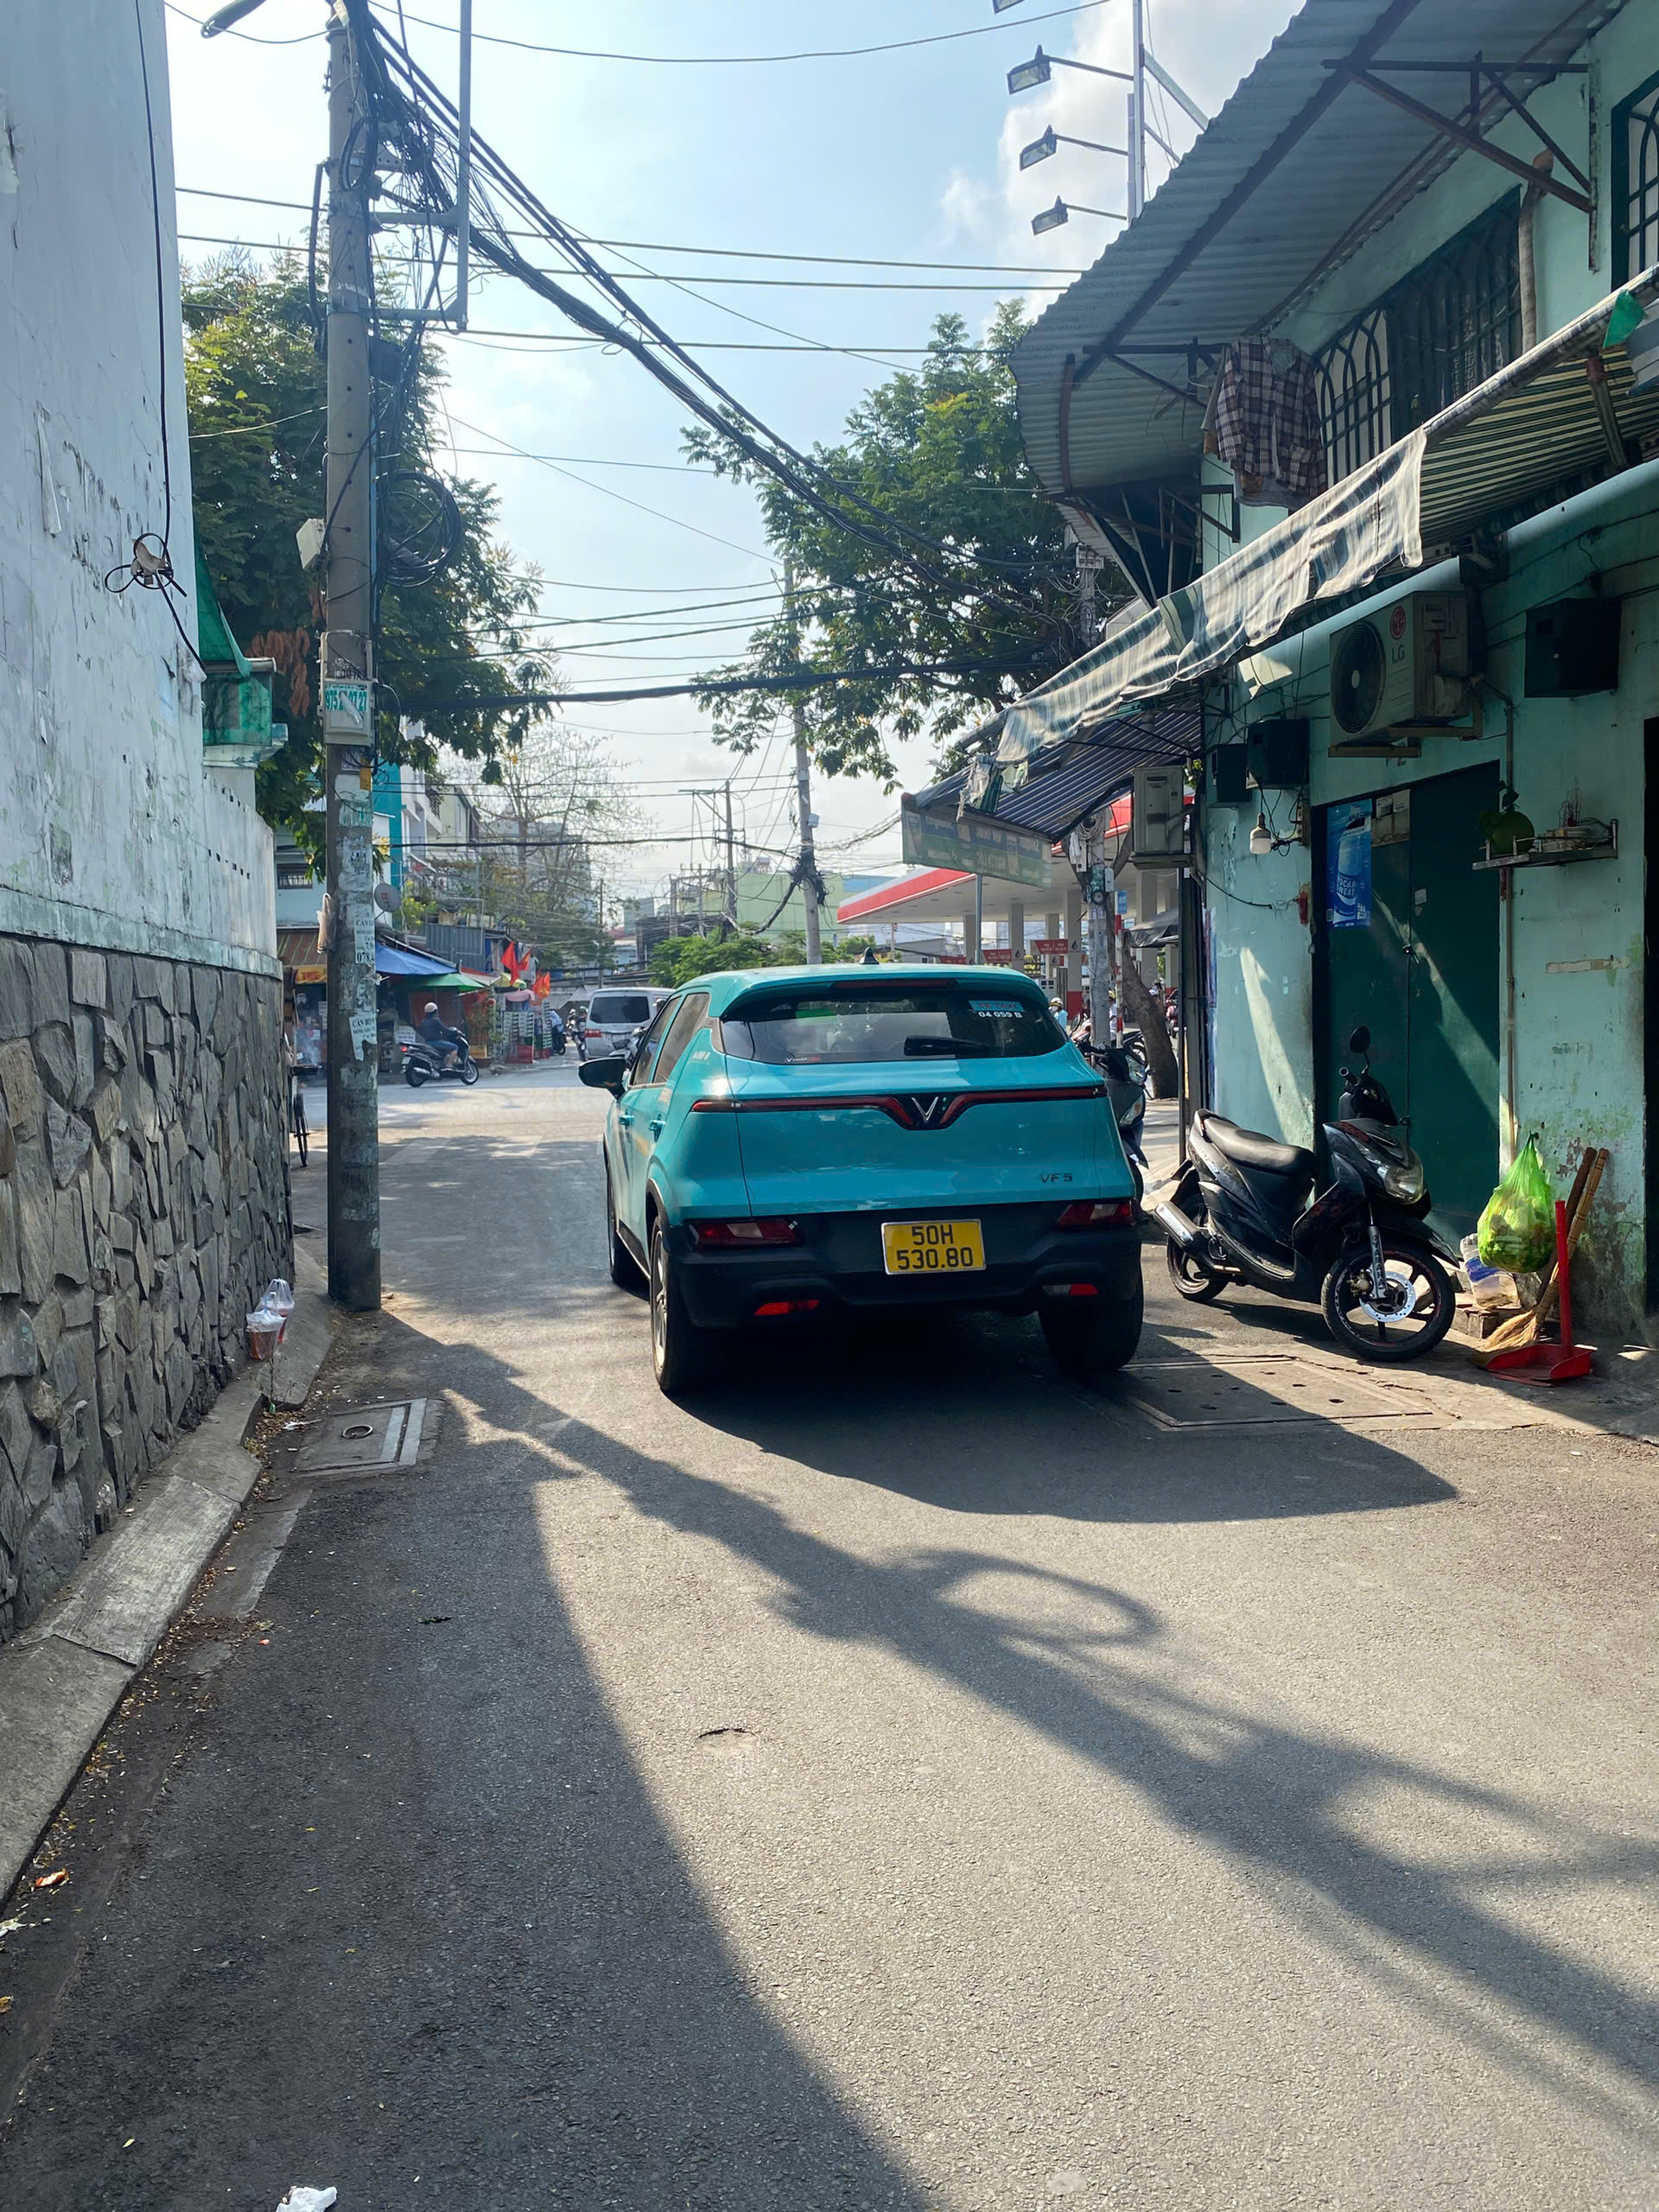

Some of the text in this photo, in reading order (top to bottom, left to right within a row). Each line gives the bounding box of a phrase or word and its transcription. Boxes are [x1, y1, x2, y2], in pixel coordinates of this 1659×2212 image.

[1391, 644, 1406, 664] LG
[912, 1224, 955, 1246] 50H
[896, 1246, 974, 1270] 530.80
